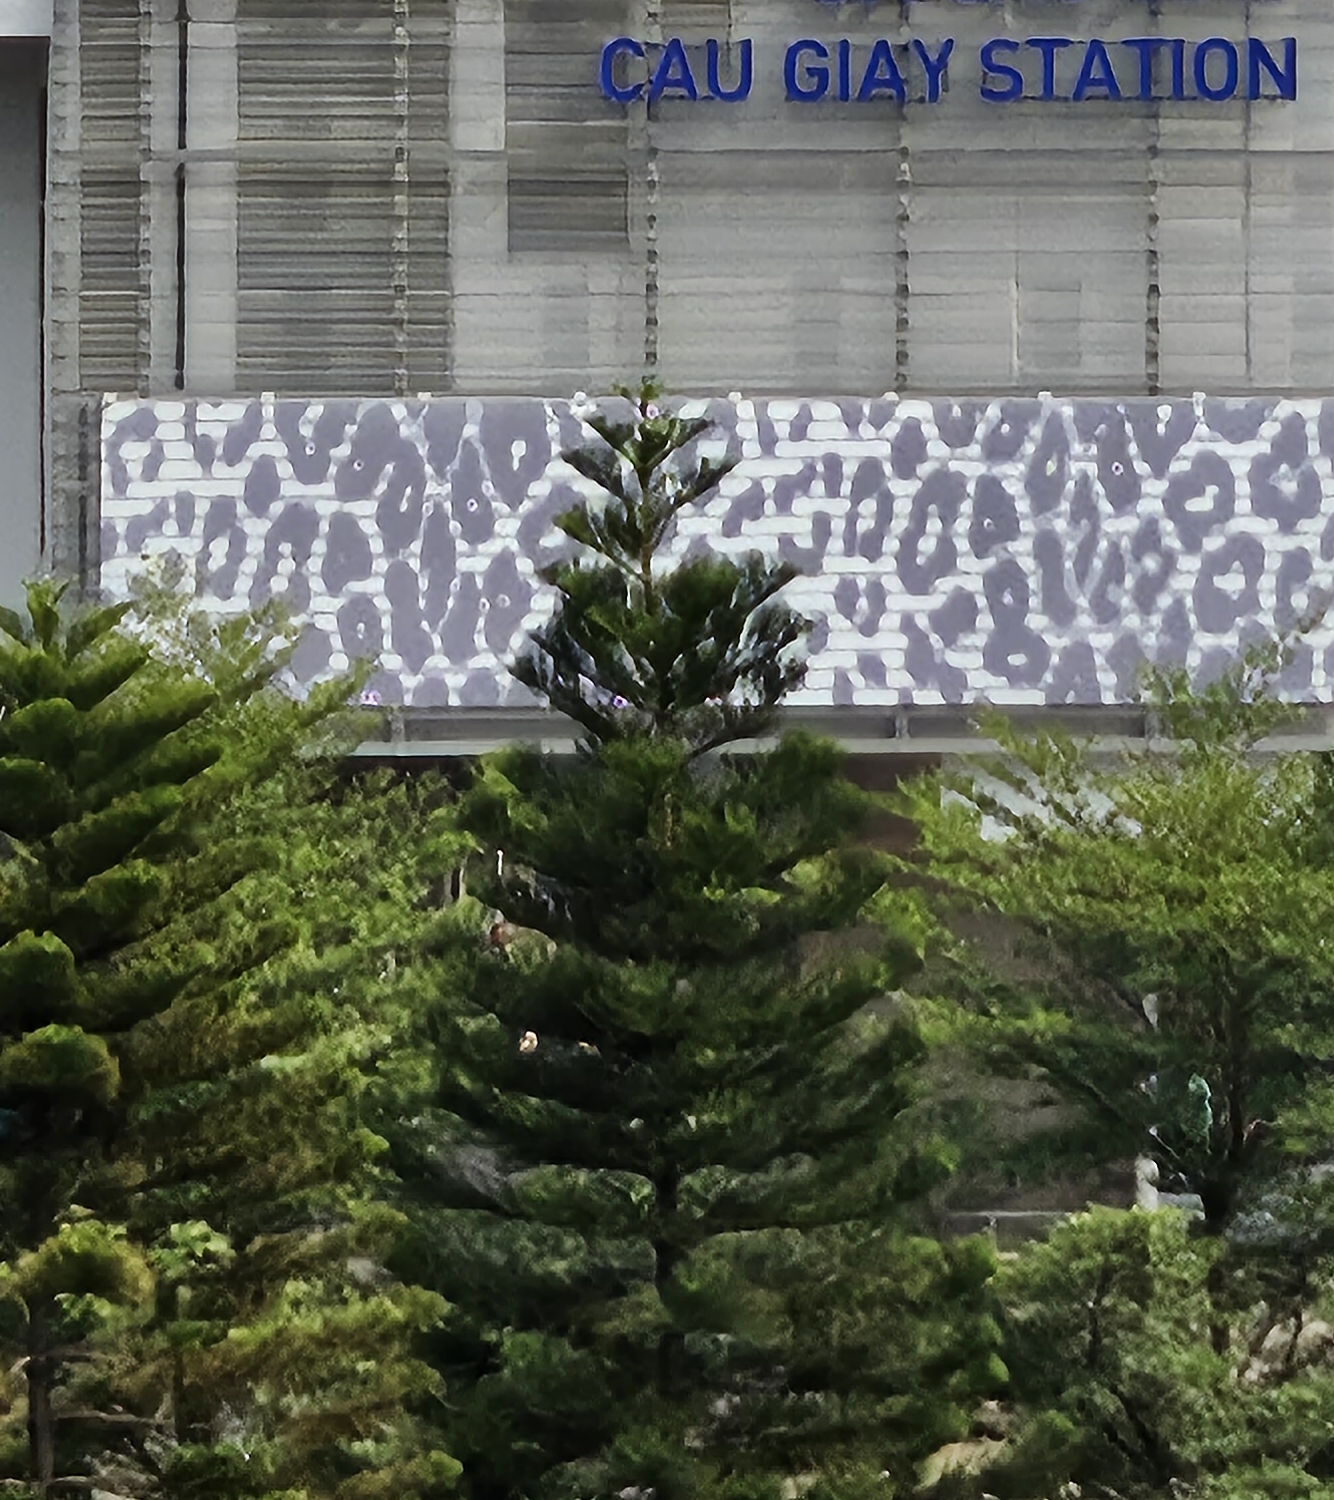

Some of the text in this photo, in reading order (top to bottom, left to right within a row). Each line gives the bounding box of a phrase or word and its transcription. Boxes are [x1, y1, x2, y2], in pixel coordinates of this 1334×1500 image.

[598, 37, 1297, 102] CAU GIAY STATION
